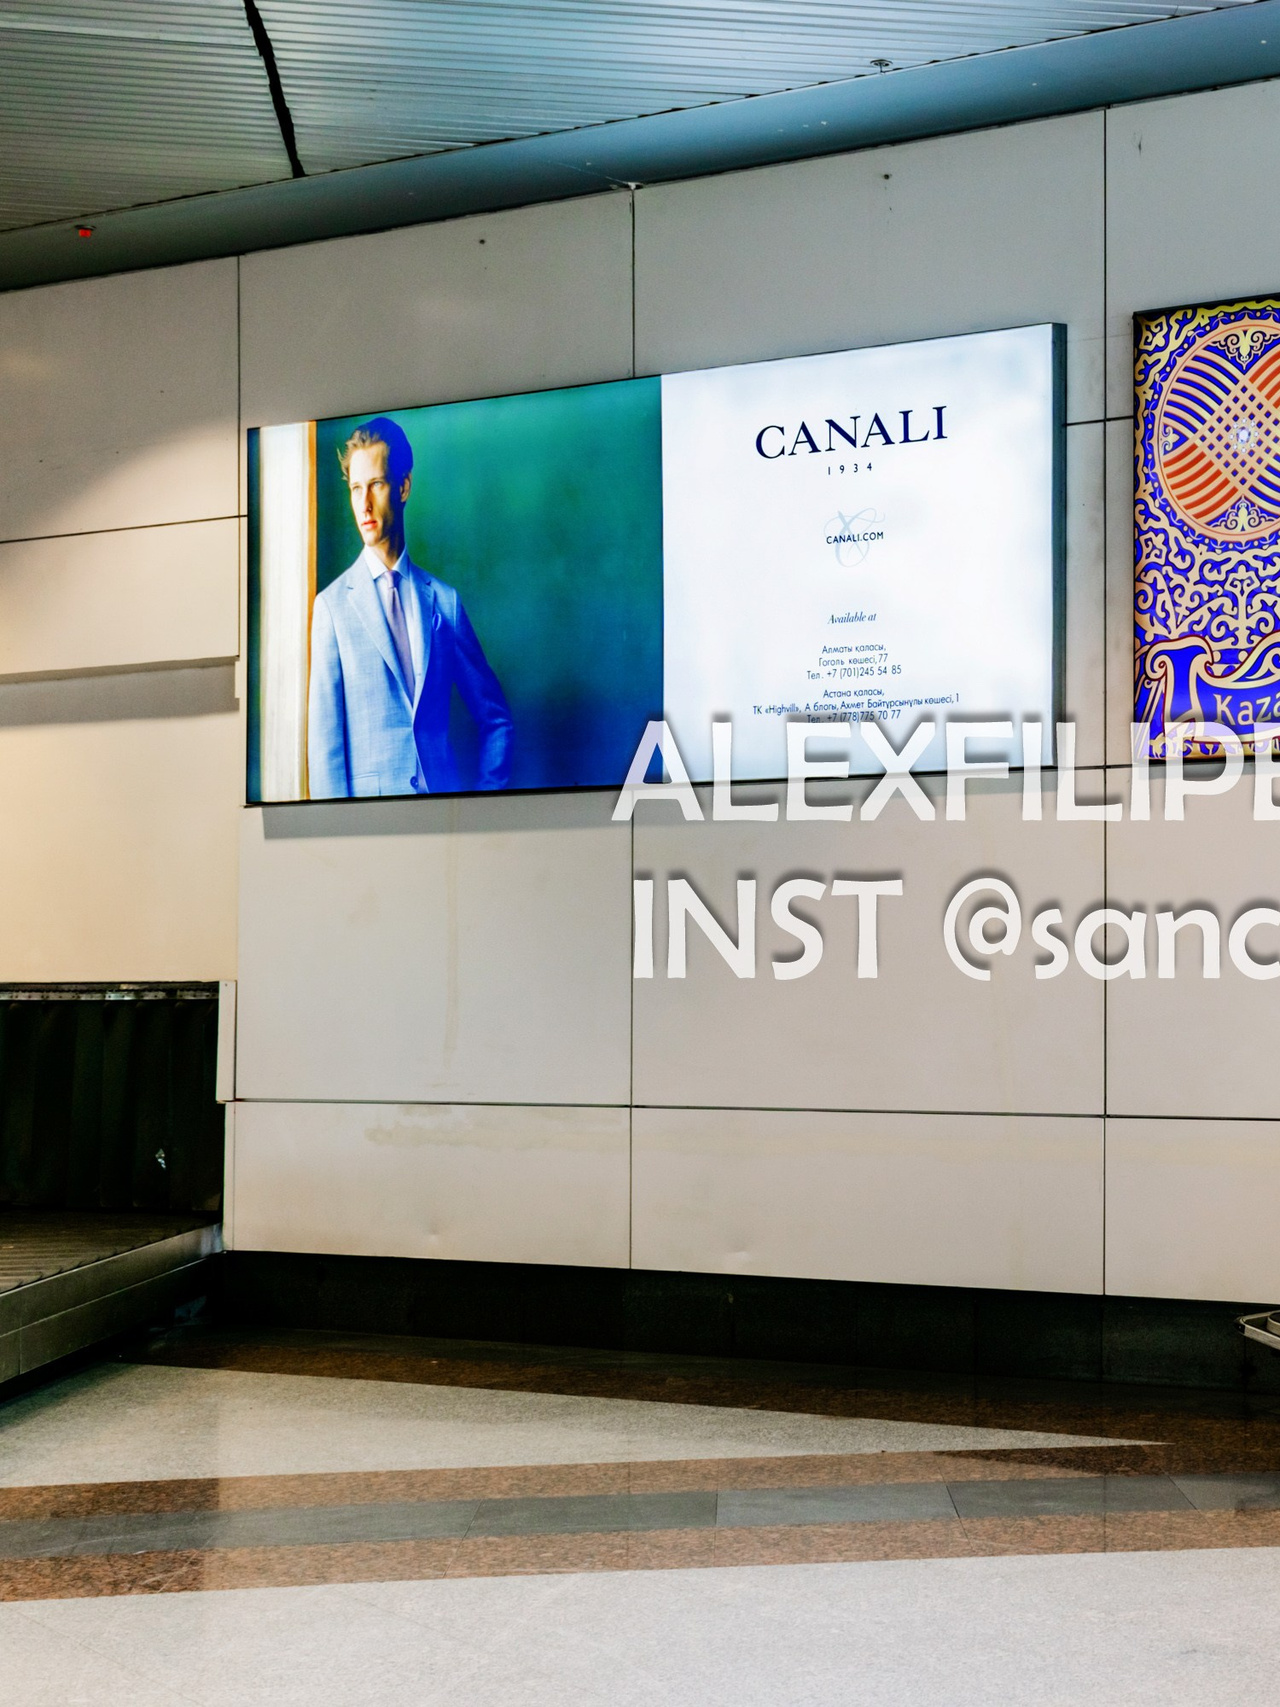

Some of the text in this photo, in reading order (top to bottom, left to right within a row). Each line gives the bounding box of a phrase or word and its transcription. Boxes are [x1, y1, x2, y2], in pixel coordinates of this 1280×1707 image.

[756, 406, 948, 459] CANALI
[826, 531, 884, 545] CANALI.COM
[827, 611, 877, 624] Available at
[822, 643, 886, 655] Алматы қаласы,
[818, 657, 845, 667] Гоголь
[807, 670, 824, 680] Тел.
[827, 669, 837, 678] +7
[877, 665, 888, 676] 54
[891, 664, 902, 675] 85
[823, 687, 885, 699] Астана қаласы,
[840, 700, 865, 710] Ахмет
[827, 713, 837, 723] +7
[878, 711, 888, 721] 70
[891, 709, 901, 720] 77
